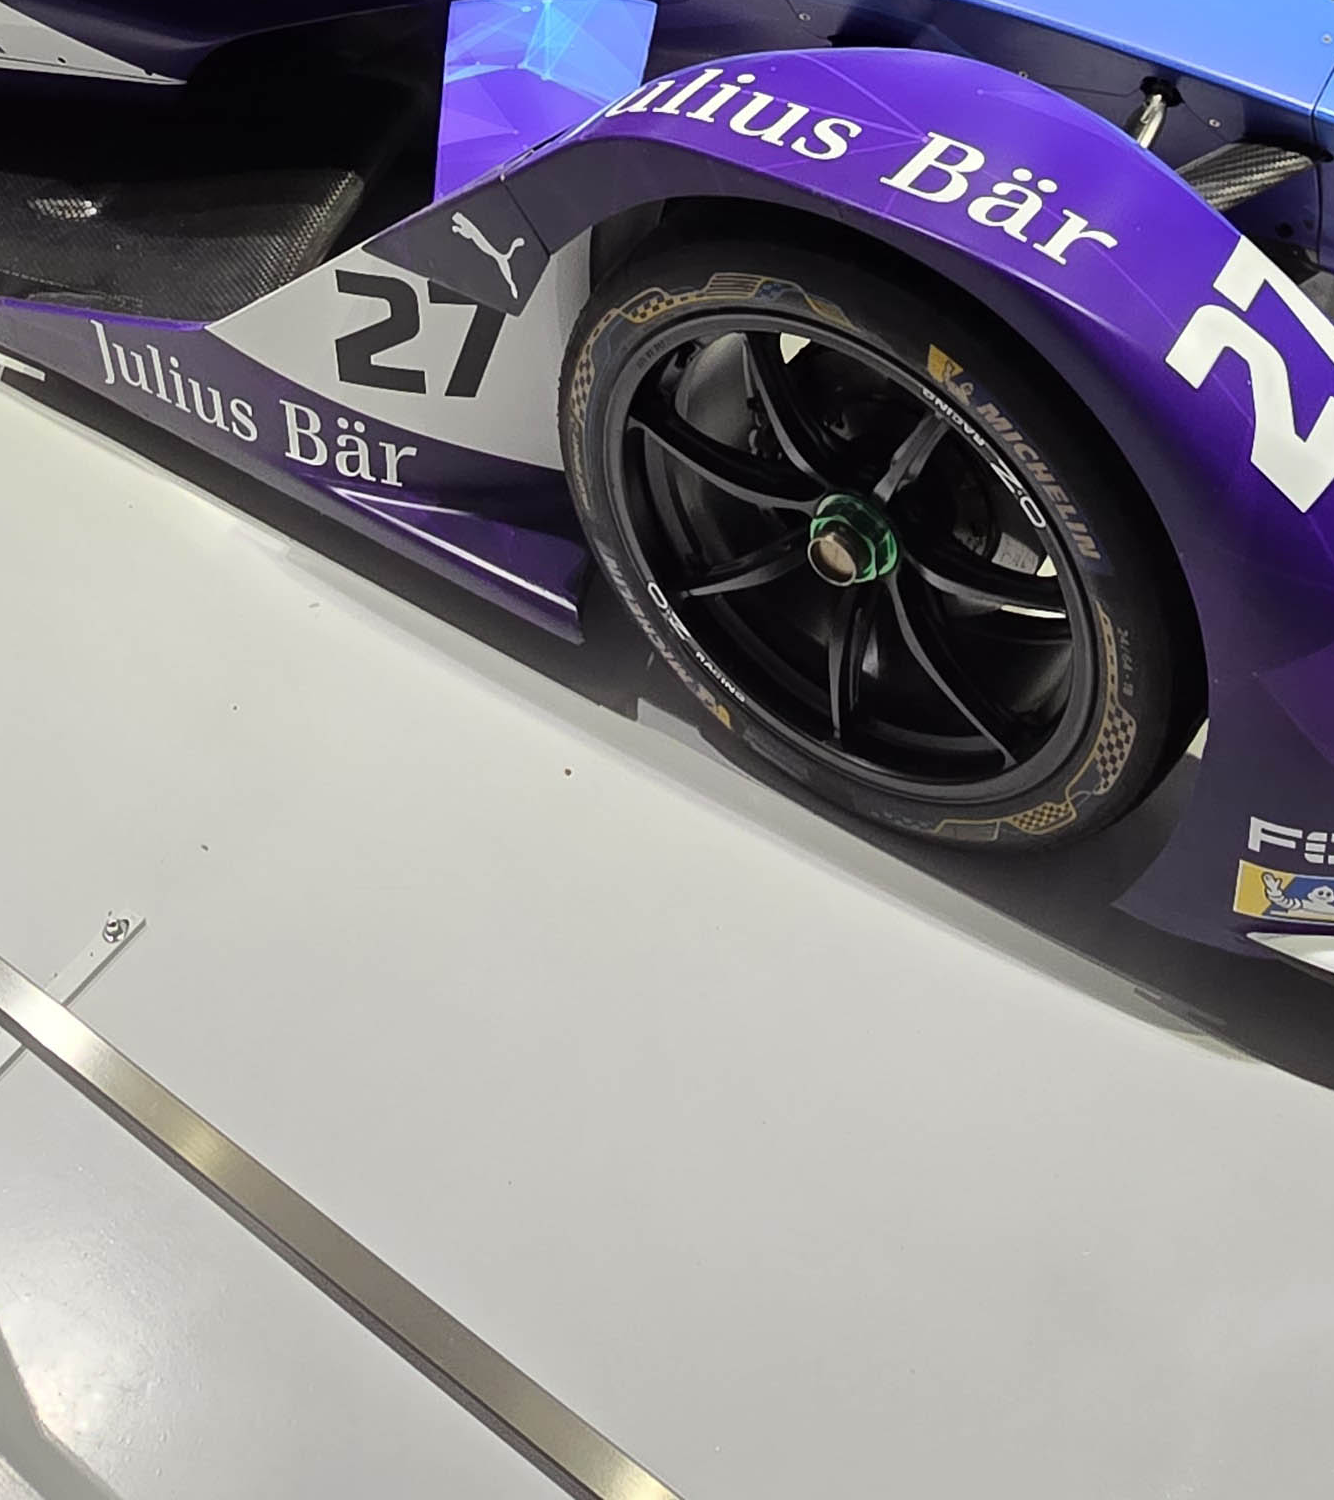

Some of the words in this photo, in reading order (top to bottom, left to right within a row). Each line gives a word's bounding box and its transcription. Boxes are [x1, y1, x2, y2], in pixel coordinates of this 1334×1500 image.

[604, 69, 863, 161] ulius
[879, 131, 1119, 267] Bär
[90, 320, 259, 444] Julius
[279, 399, 418, 488] Bär
[334, 270, 508, 398] 27
[921, 388, 987, 448] RACING
[976, 402, 1102, 560] MICHELIN
[695, 651, 746, 703] RACING
